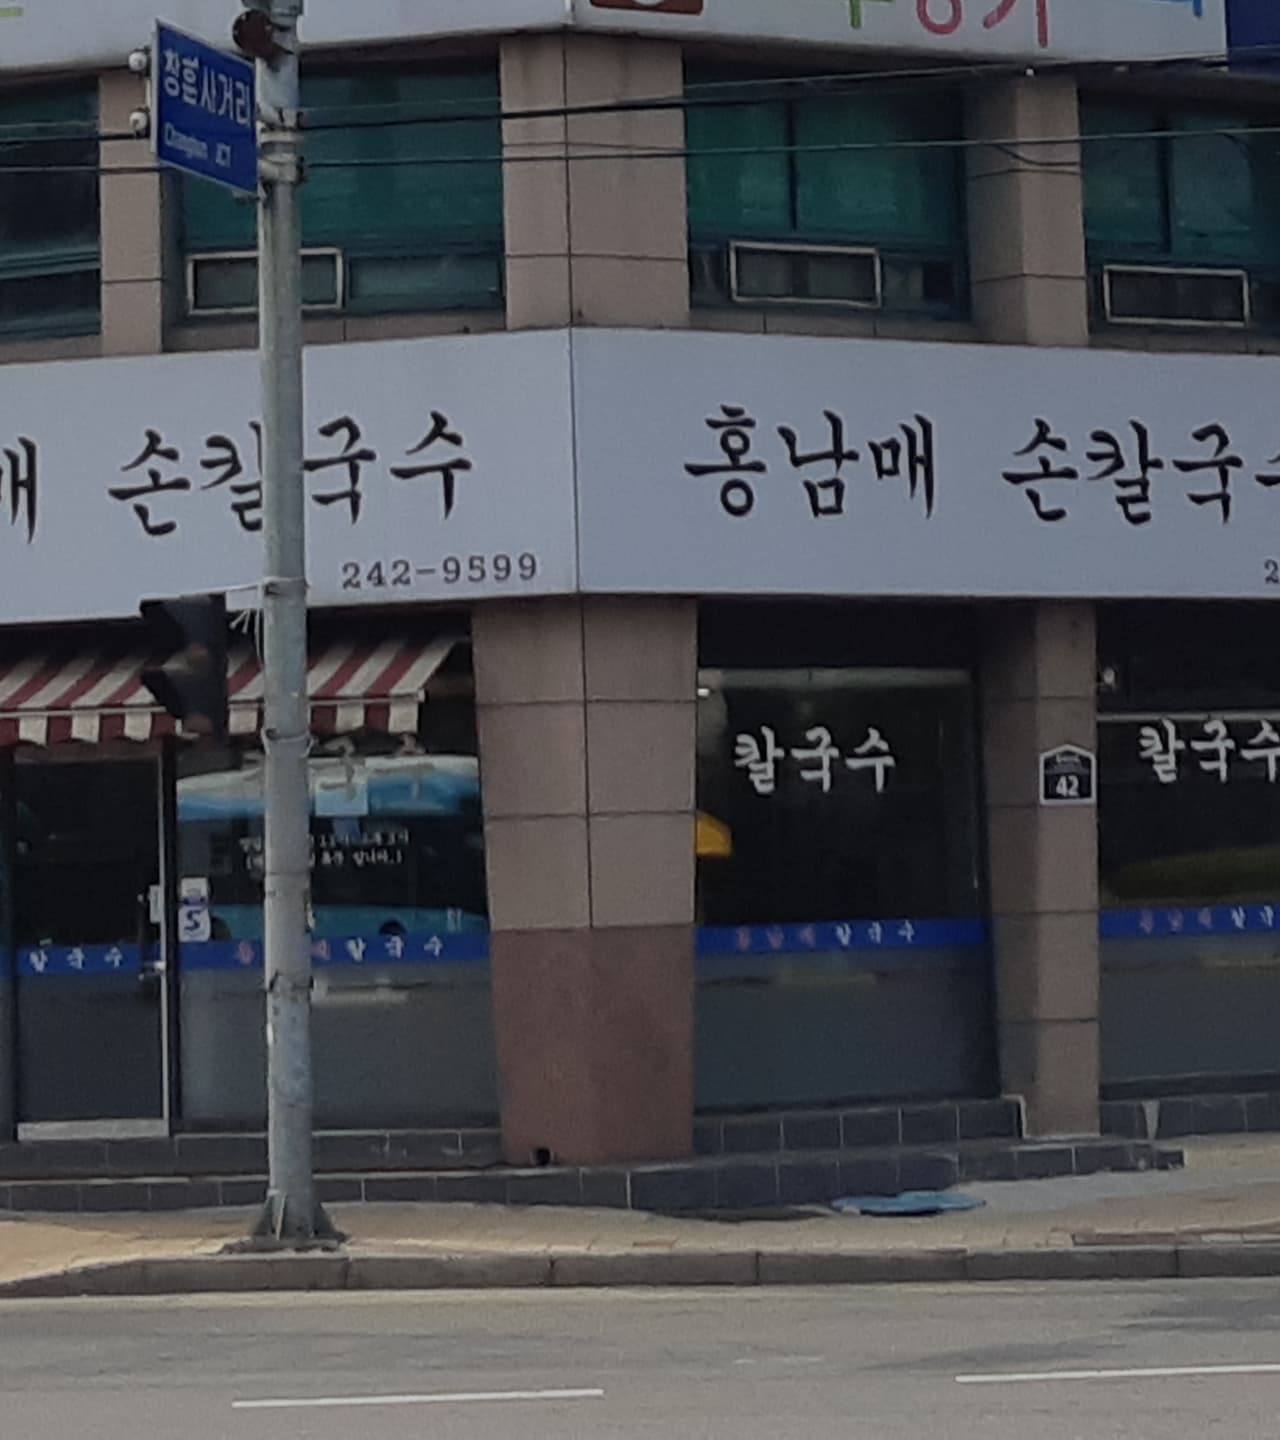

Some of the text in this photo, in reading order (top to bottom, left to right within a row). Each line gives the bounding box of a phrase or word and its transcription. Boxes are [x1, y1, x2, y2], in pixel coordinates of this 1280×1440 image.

[107, 410, 476, 537] 손칼국수
[684, 404, 936, 520] 홍남매
[341, 552, 540, 590] 242-9599
[734, 726, 896, 794] 칼국수
[1056, 774, 1080, 797] 42
